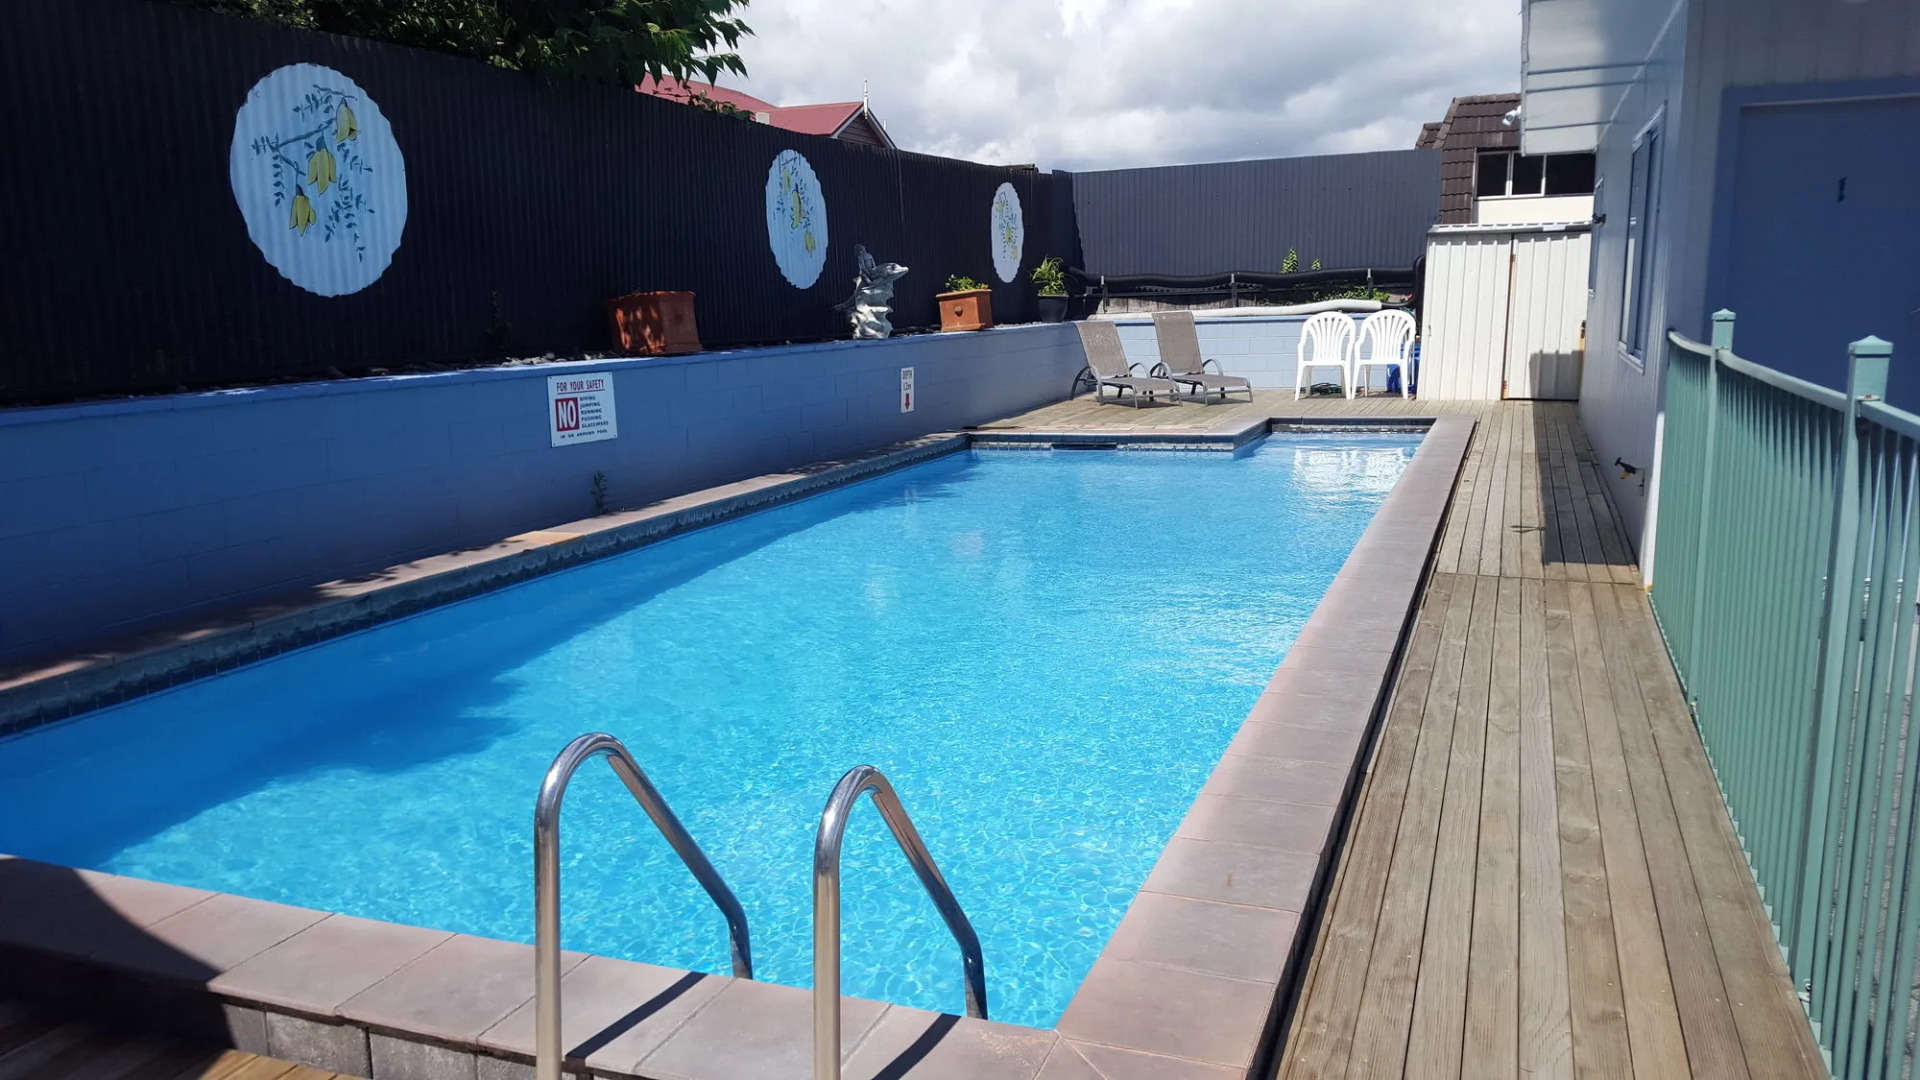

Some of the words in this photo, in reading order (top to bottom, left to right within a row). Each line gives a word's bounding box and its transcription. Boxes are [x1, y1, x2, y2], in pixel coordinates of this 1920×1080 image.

[556, 382, 568, 392] FOR
[569, 381, 584, 391] YOUR
[586, 379, 604, 390] SAFETY
[558, 400, 577, 429] NO
